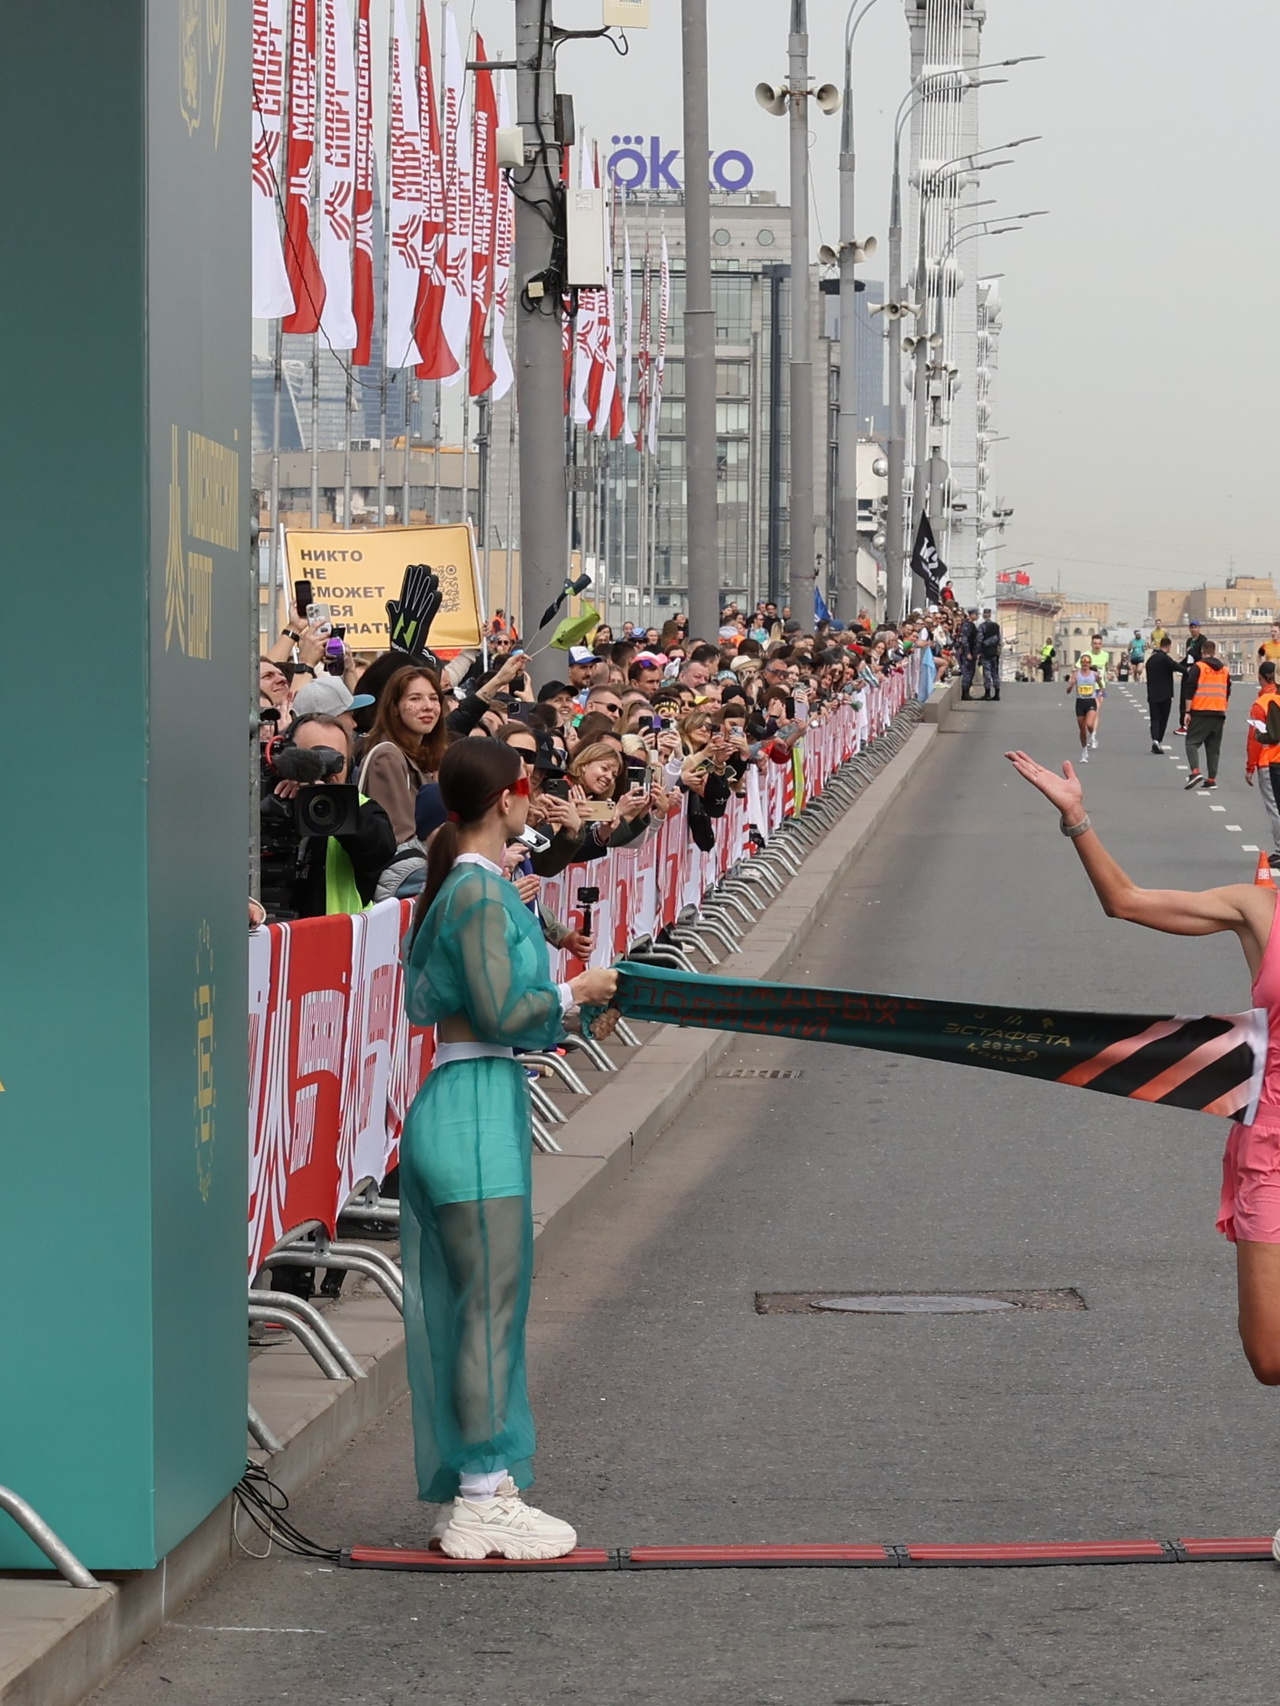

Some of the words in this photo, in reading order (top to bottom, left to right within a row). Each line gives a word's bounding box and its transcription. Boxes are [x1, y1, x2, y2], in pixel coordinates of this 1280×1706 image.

[292, 0, 308, 140] МОСКОВС
[325, 0, 336, 166] МОСКОВСКИ
[300, 549, 362, 562] НИКТО
[303, 568, 326, 579] НЕ
[329, 605, 353, 617] БЯ
[943, 1022, 1071, 1048] ЭСТАФЕТА
[981, 1040, 1023, 1053] 2025
